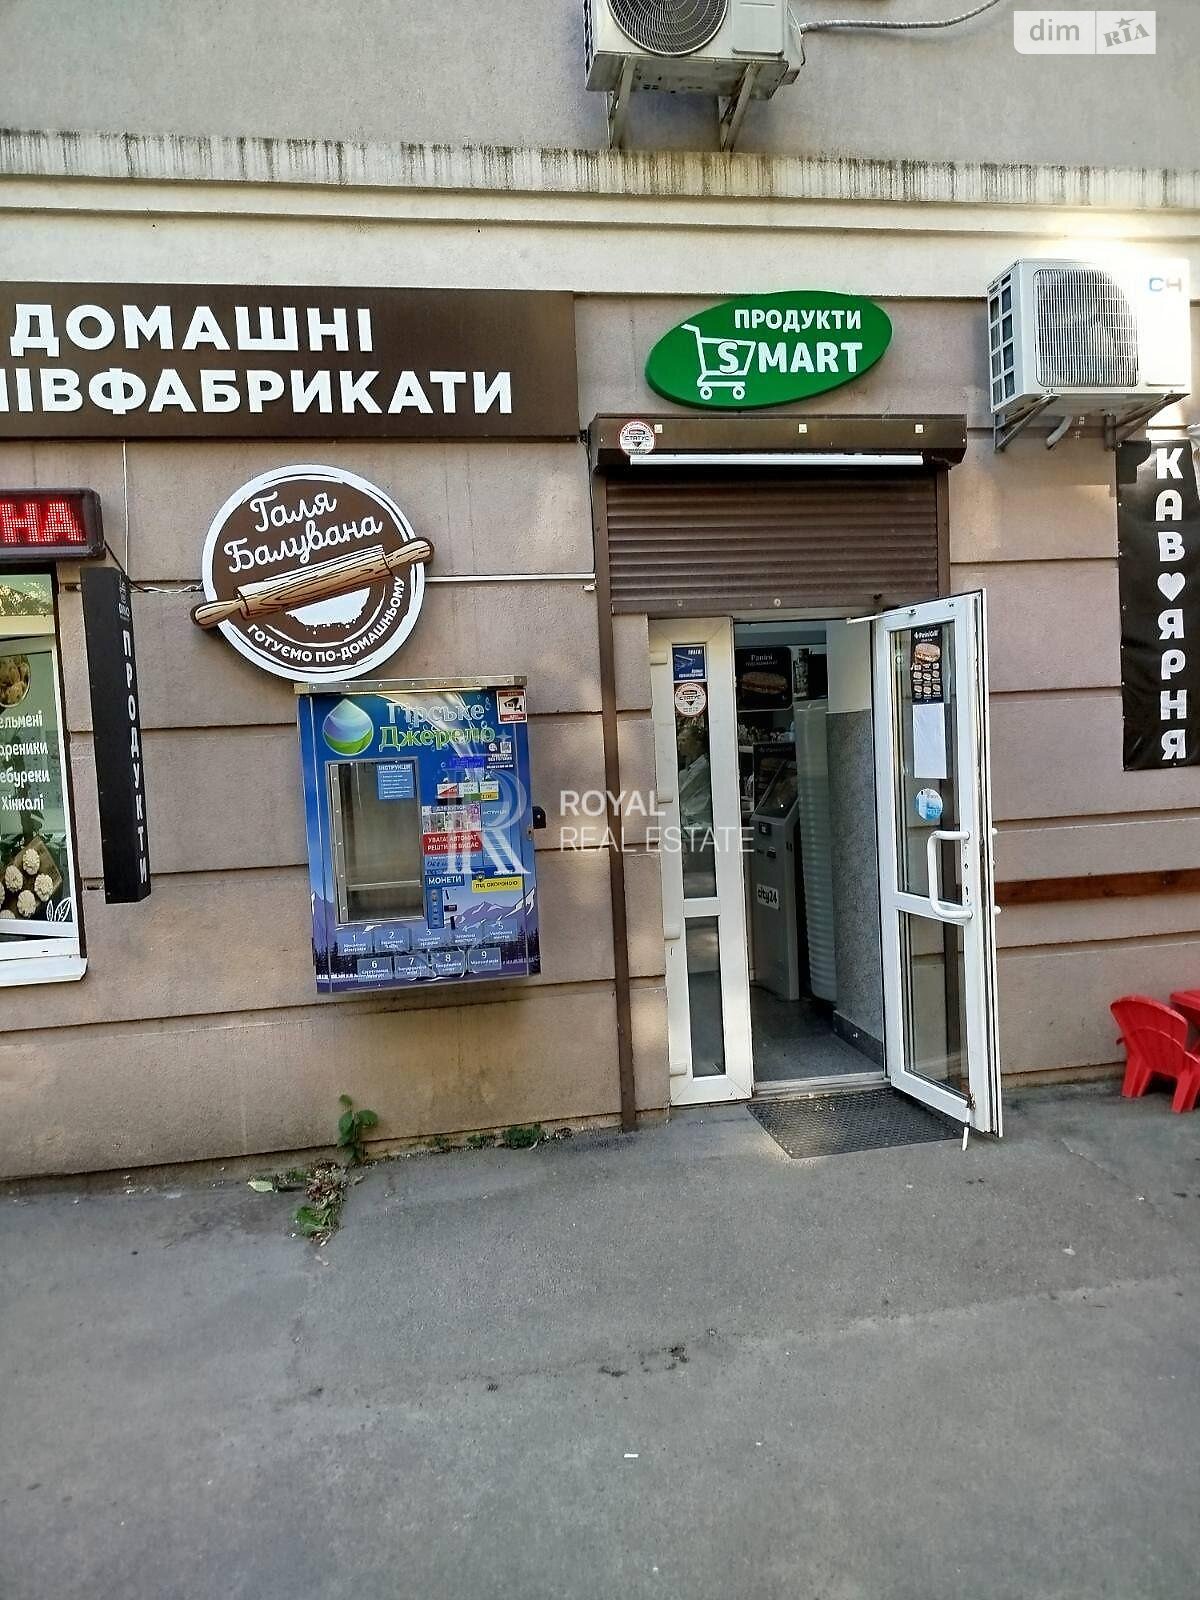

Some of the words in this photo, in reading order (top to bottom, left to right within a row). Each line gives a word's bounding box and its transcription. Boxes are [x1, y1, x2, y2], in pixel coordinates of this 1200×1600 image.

[10, 303, 374, 358] ДОМАШНІ
[734, 308, 861, 332] ПРОДУКТИ
[718, 340, 863, 374] SMART
[0, 366, 512, 415] ІВФАБРИКАТИ
[250, 490, 338, 533] Галя
[223, 514, 384, 574] Балувана
[246, 622, 314, 663] ГОТУЄМО
[315, 576, 406, 663] ПО-ДОМАШНЬОМУ
[386, 702, 485, 727] Гірське
[122, 629, 148, 884] ПРОДУКТИ
[379, 725, 496, 753] Джерело
[1, 793, 45, 811] Хінкалі
[428, 875, 462, 885] МОНЕТИ
